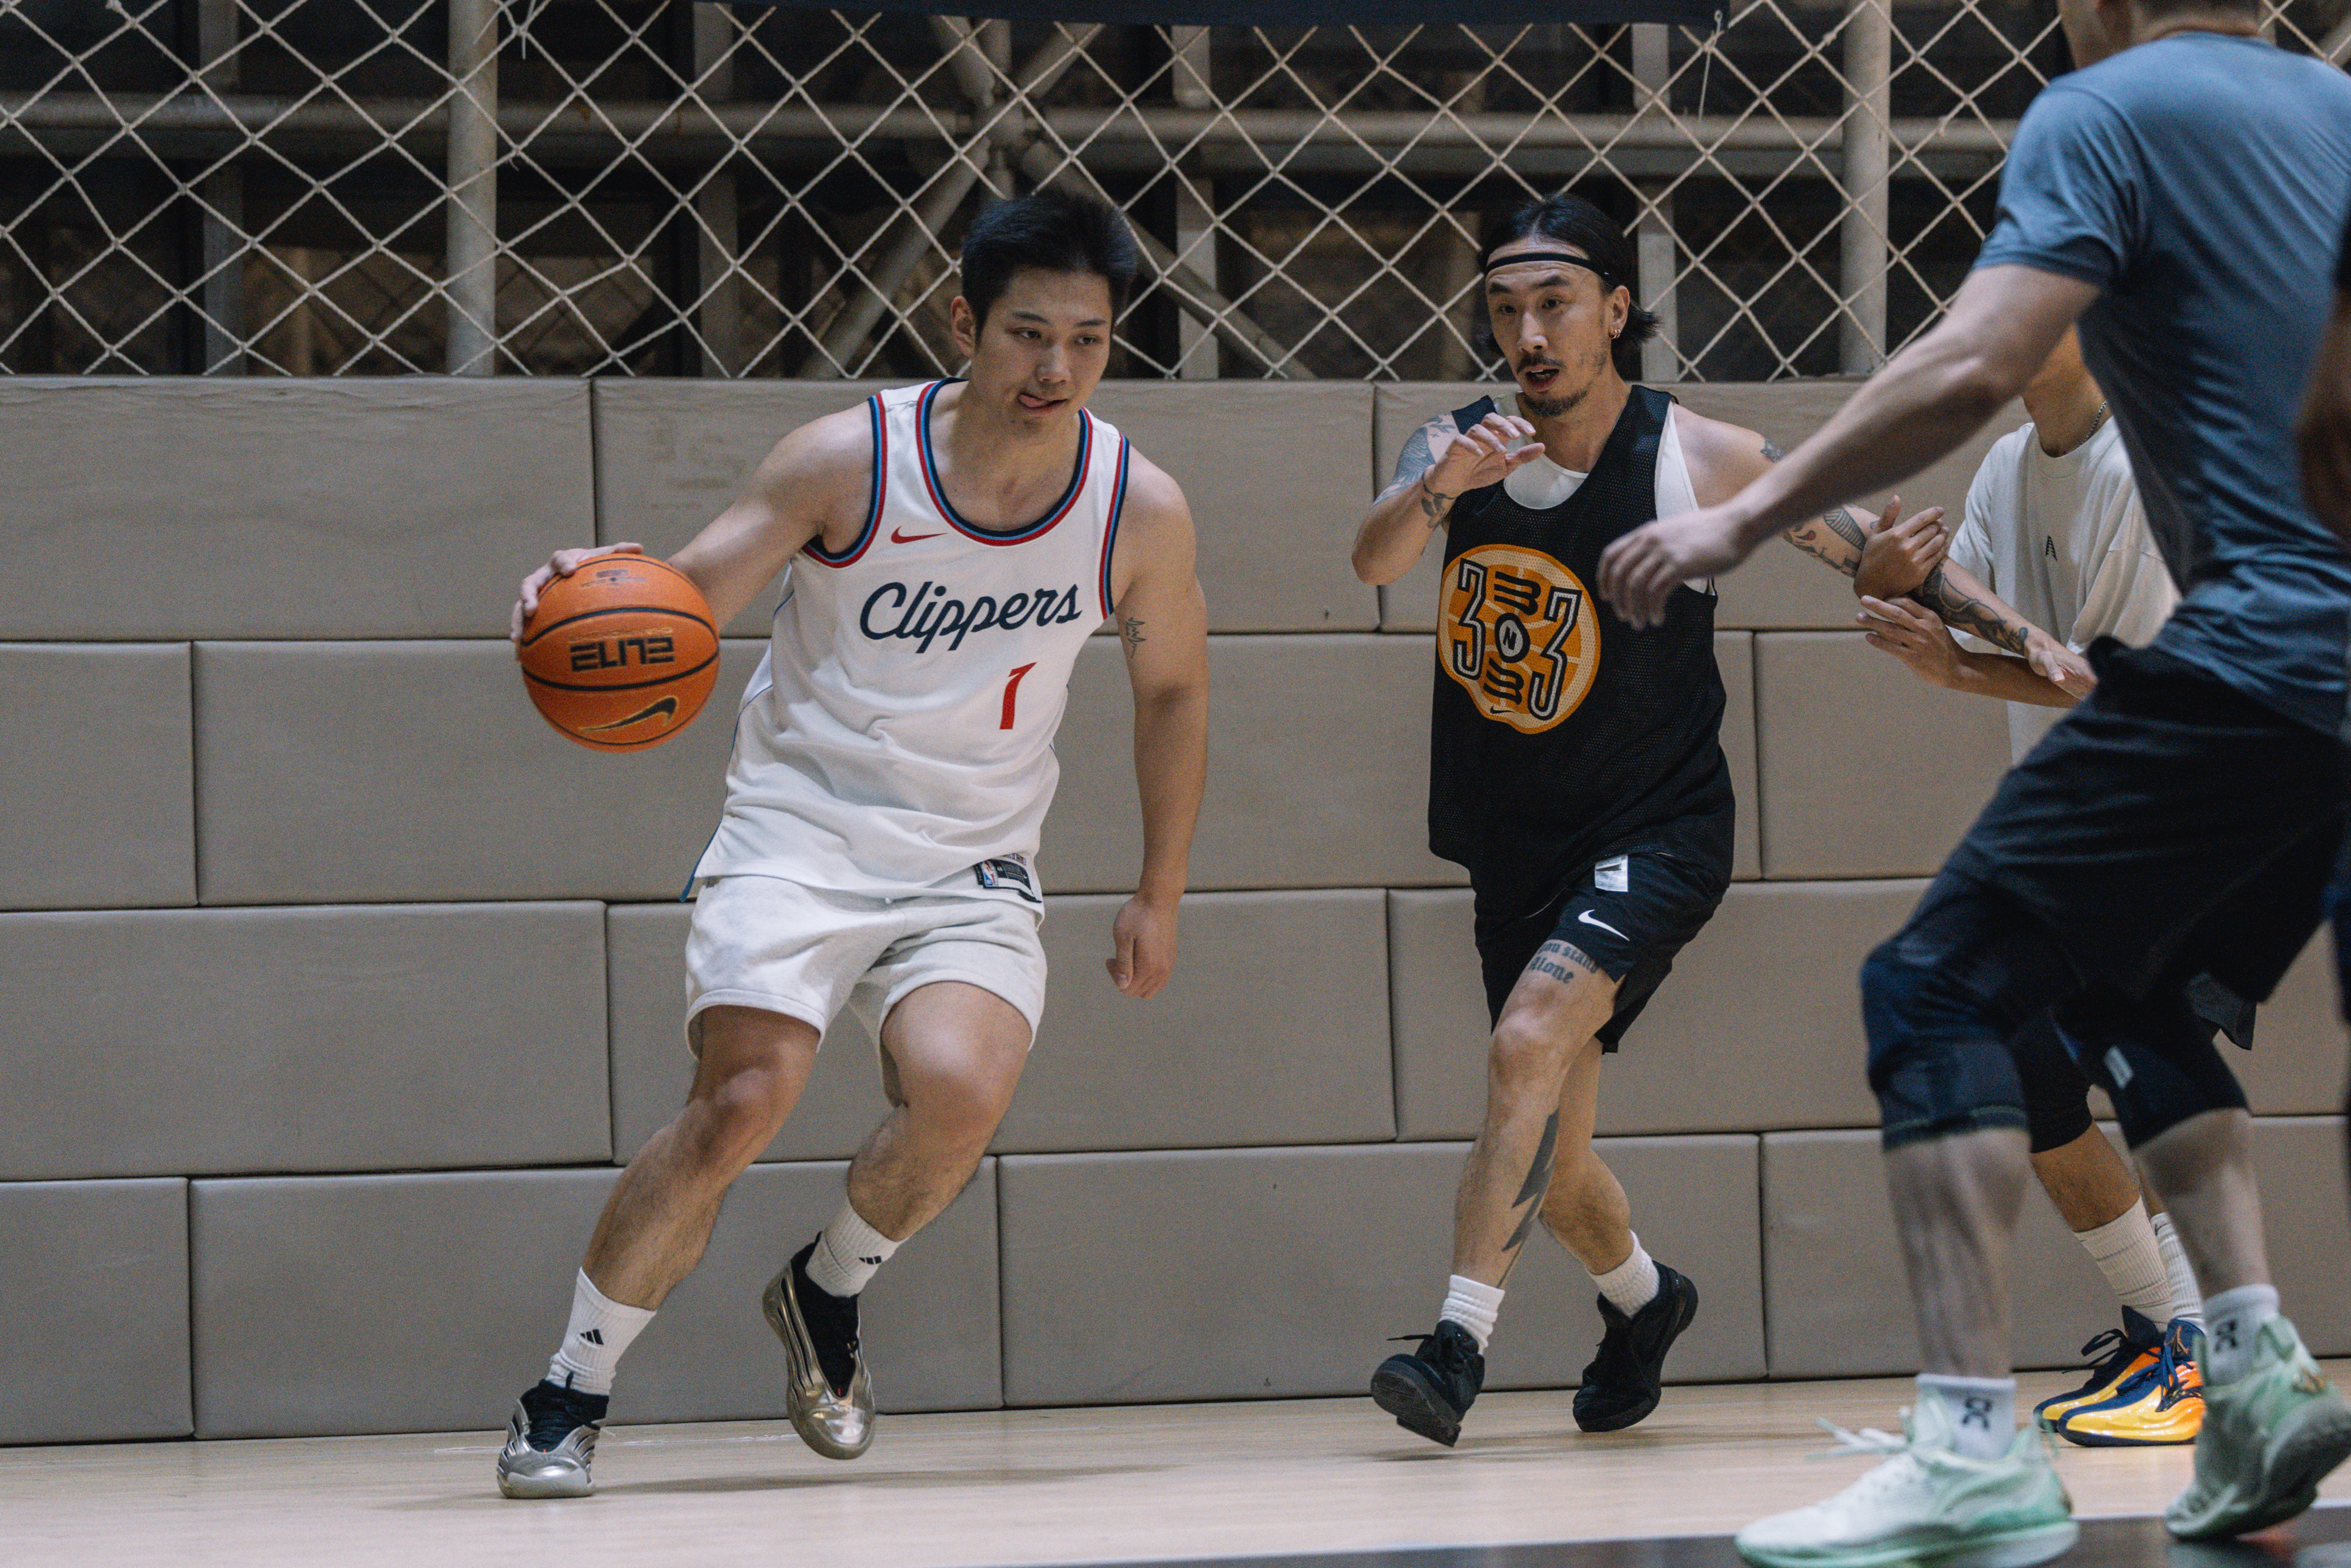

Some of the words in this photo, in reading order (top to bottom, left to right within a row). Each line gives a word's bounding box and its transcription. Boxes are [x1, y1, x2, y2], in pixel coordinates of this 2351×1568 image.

[859, 581, 1083, 654] Clippers
[571, 638, 674, 671] ELITE
[999, 662, 1037, 730] 1
[1529, 957, 1574, 984] alone
